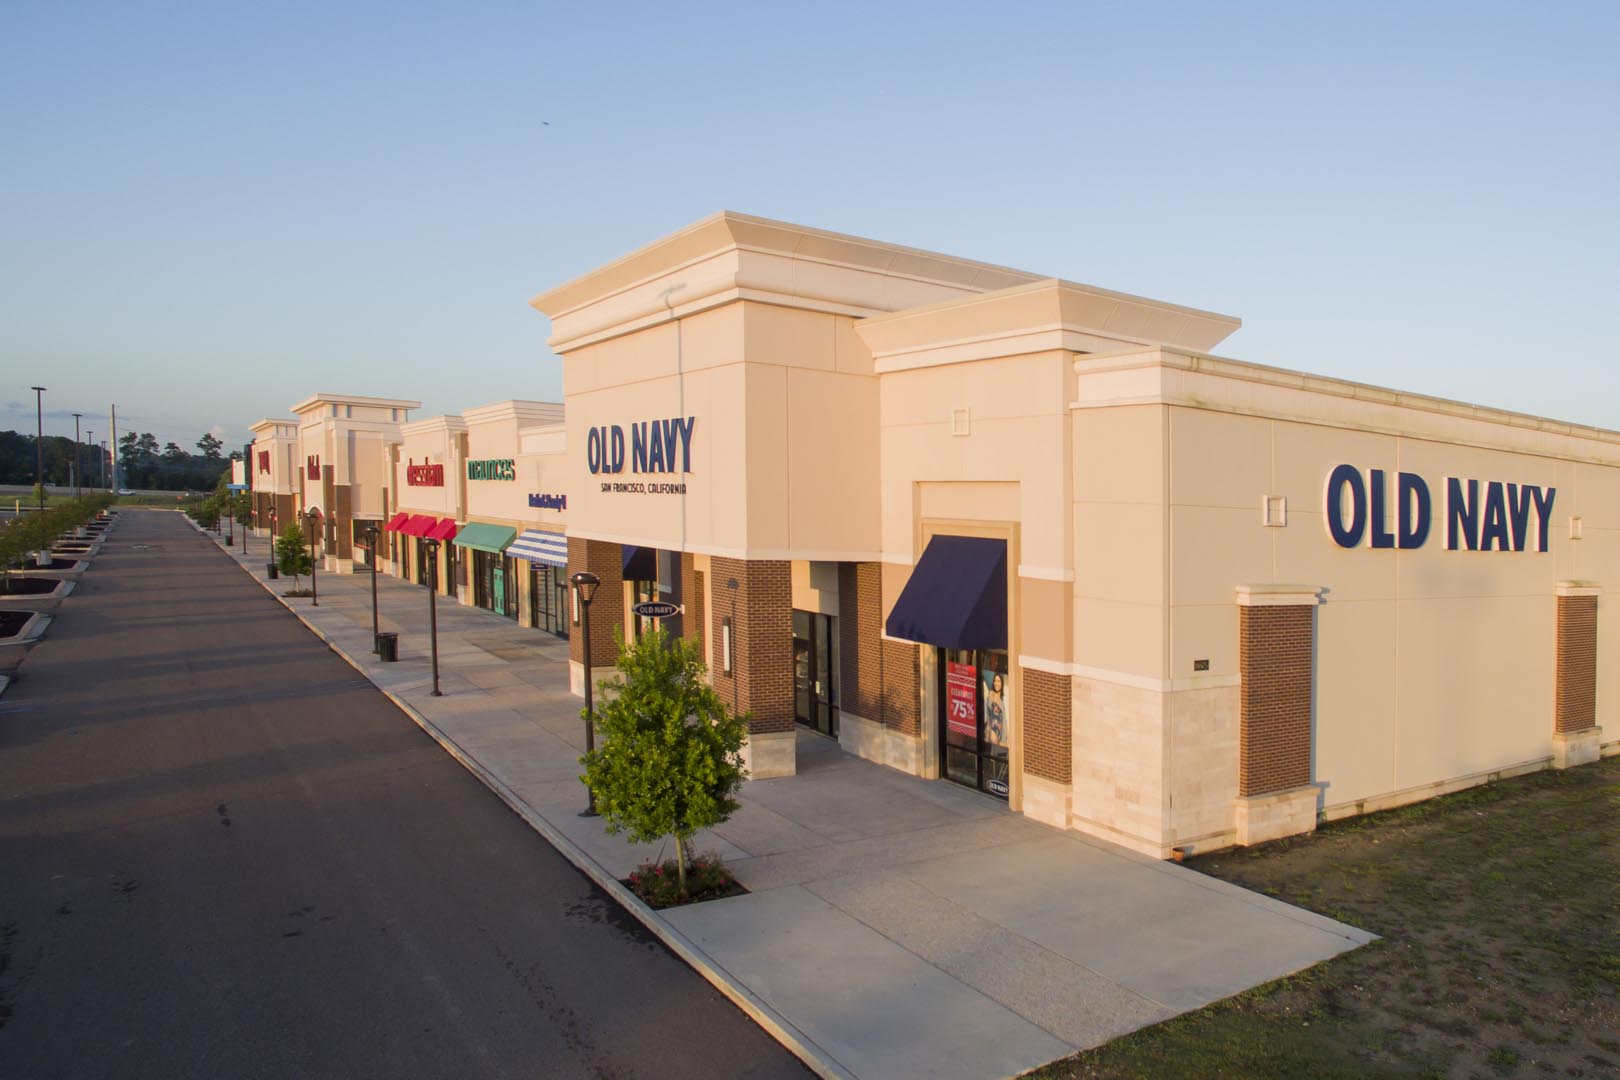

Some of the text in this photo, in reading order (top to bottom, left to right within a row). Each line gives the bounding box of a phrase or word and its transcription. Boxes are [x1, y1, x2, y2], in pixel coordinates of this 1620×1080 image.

[588, 416, 696, 474] OLD NAVY
[601, 483, 612, 493] SAN
[648, 483, 687, 495] CALIFORNIA
[1324, 464, 1557, 553] OLD NAVY
[639, 606, 673, 614] OLD NAVY
